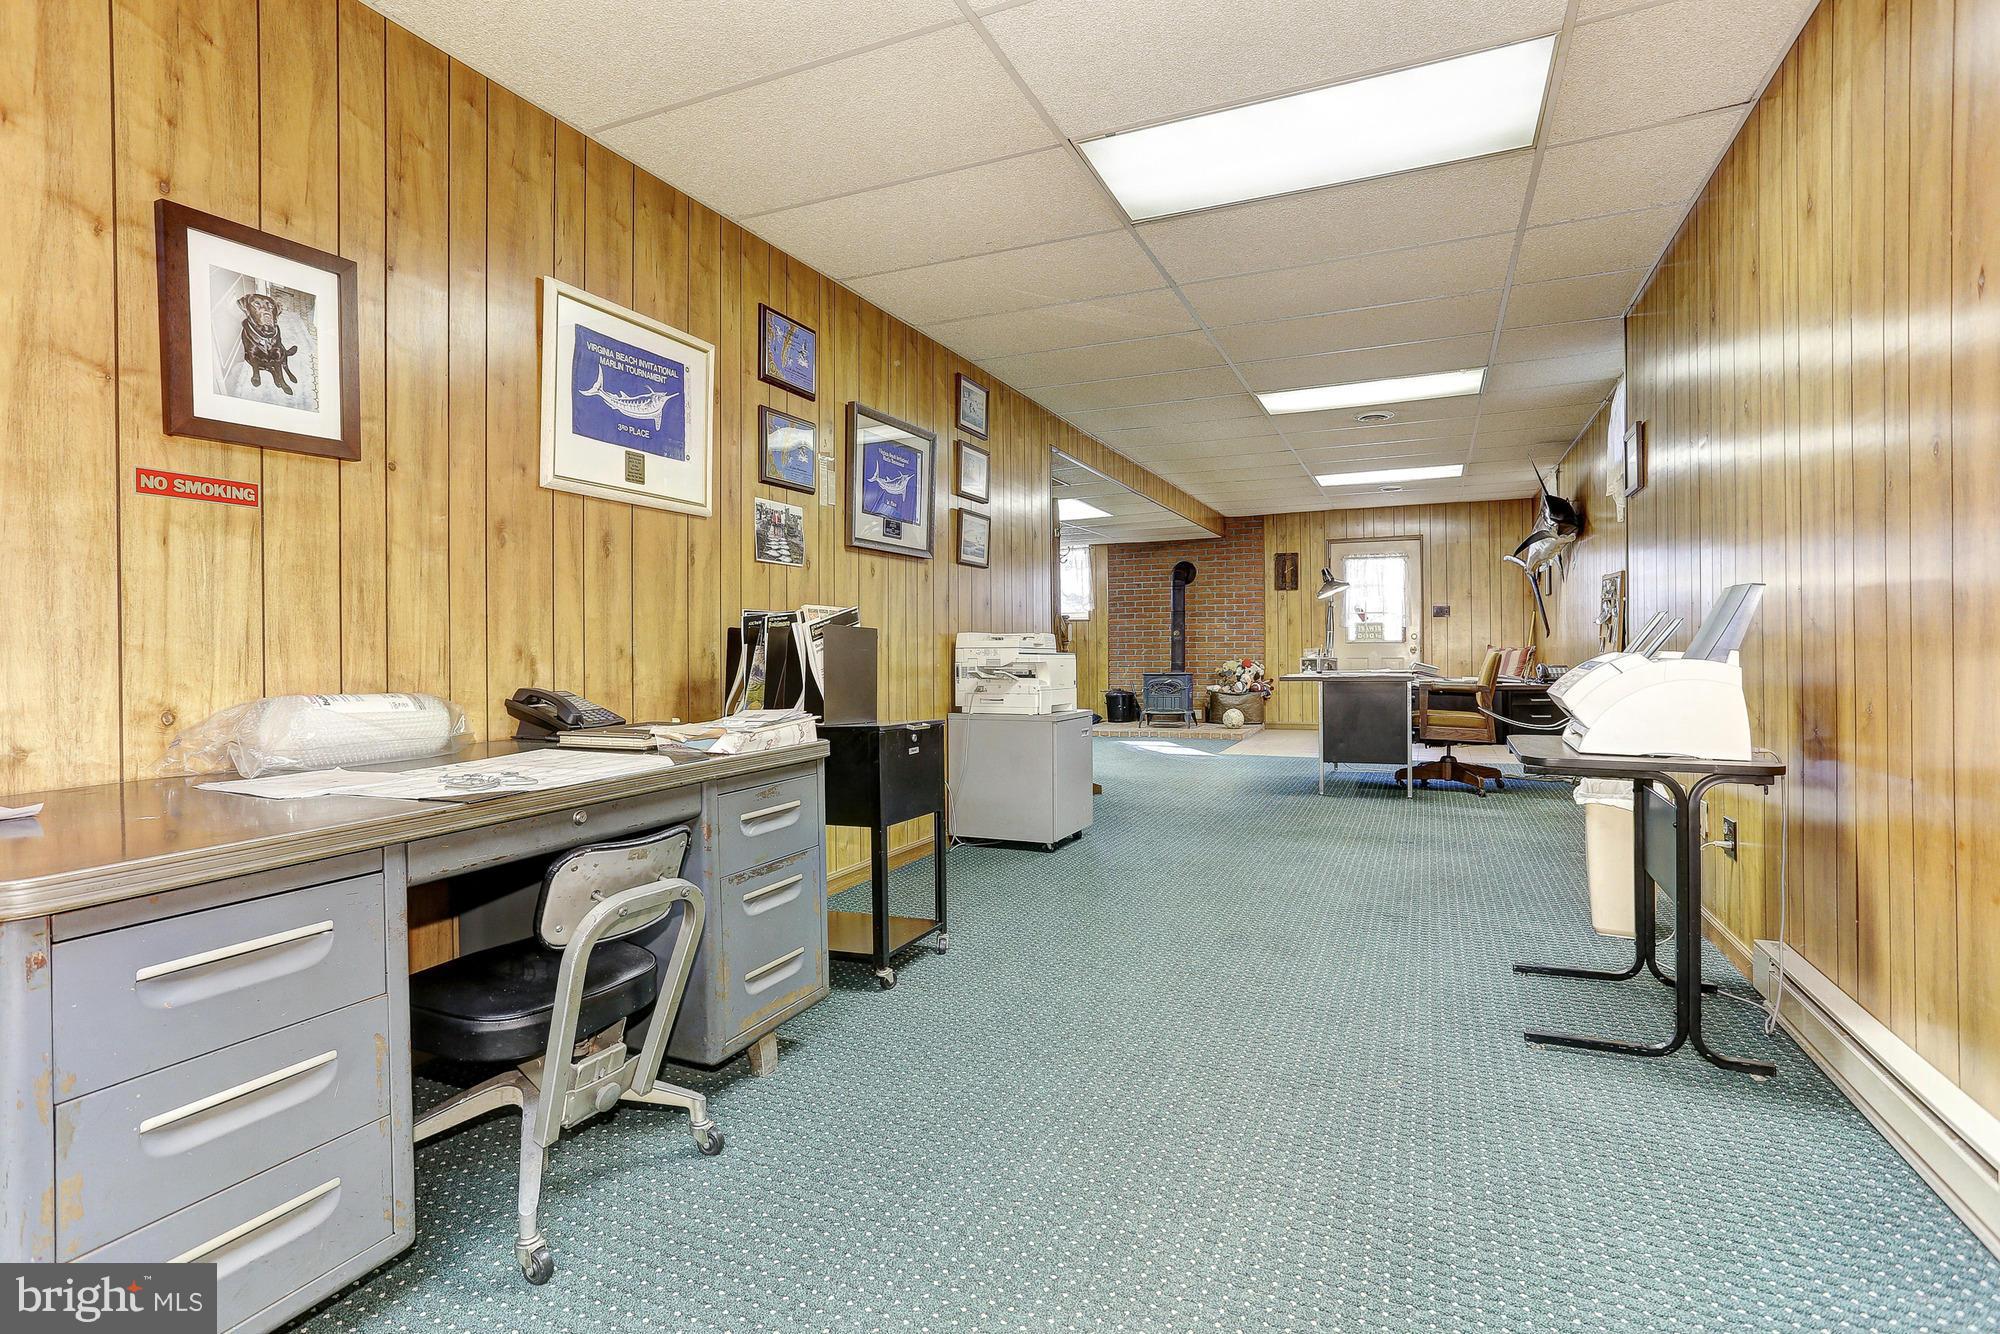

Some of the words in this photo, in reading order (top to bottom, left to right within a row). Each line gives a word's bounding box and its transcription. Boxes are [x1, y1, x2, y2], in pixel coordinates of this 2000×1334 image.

[586, 341, 615, 358] VIRGINIA
[615, 351, 638, 366] BEACH
[638, 358, 679, 378] INVITATIONAL
[599, 356, 624, 371] MARLIN
[625, 364, 667, 384] TOURNAMENT
[629, 426, 650, 438] PLACE
[140, 473, 168, 490] NO
[173, 478, 256, 502] SMOKING
